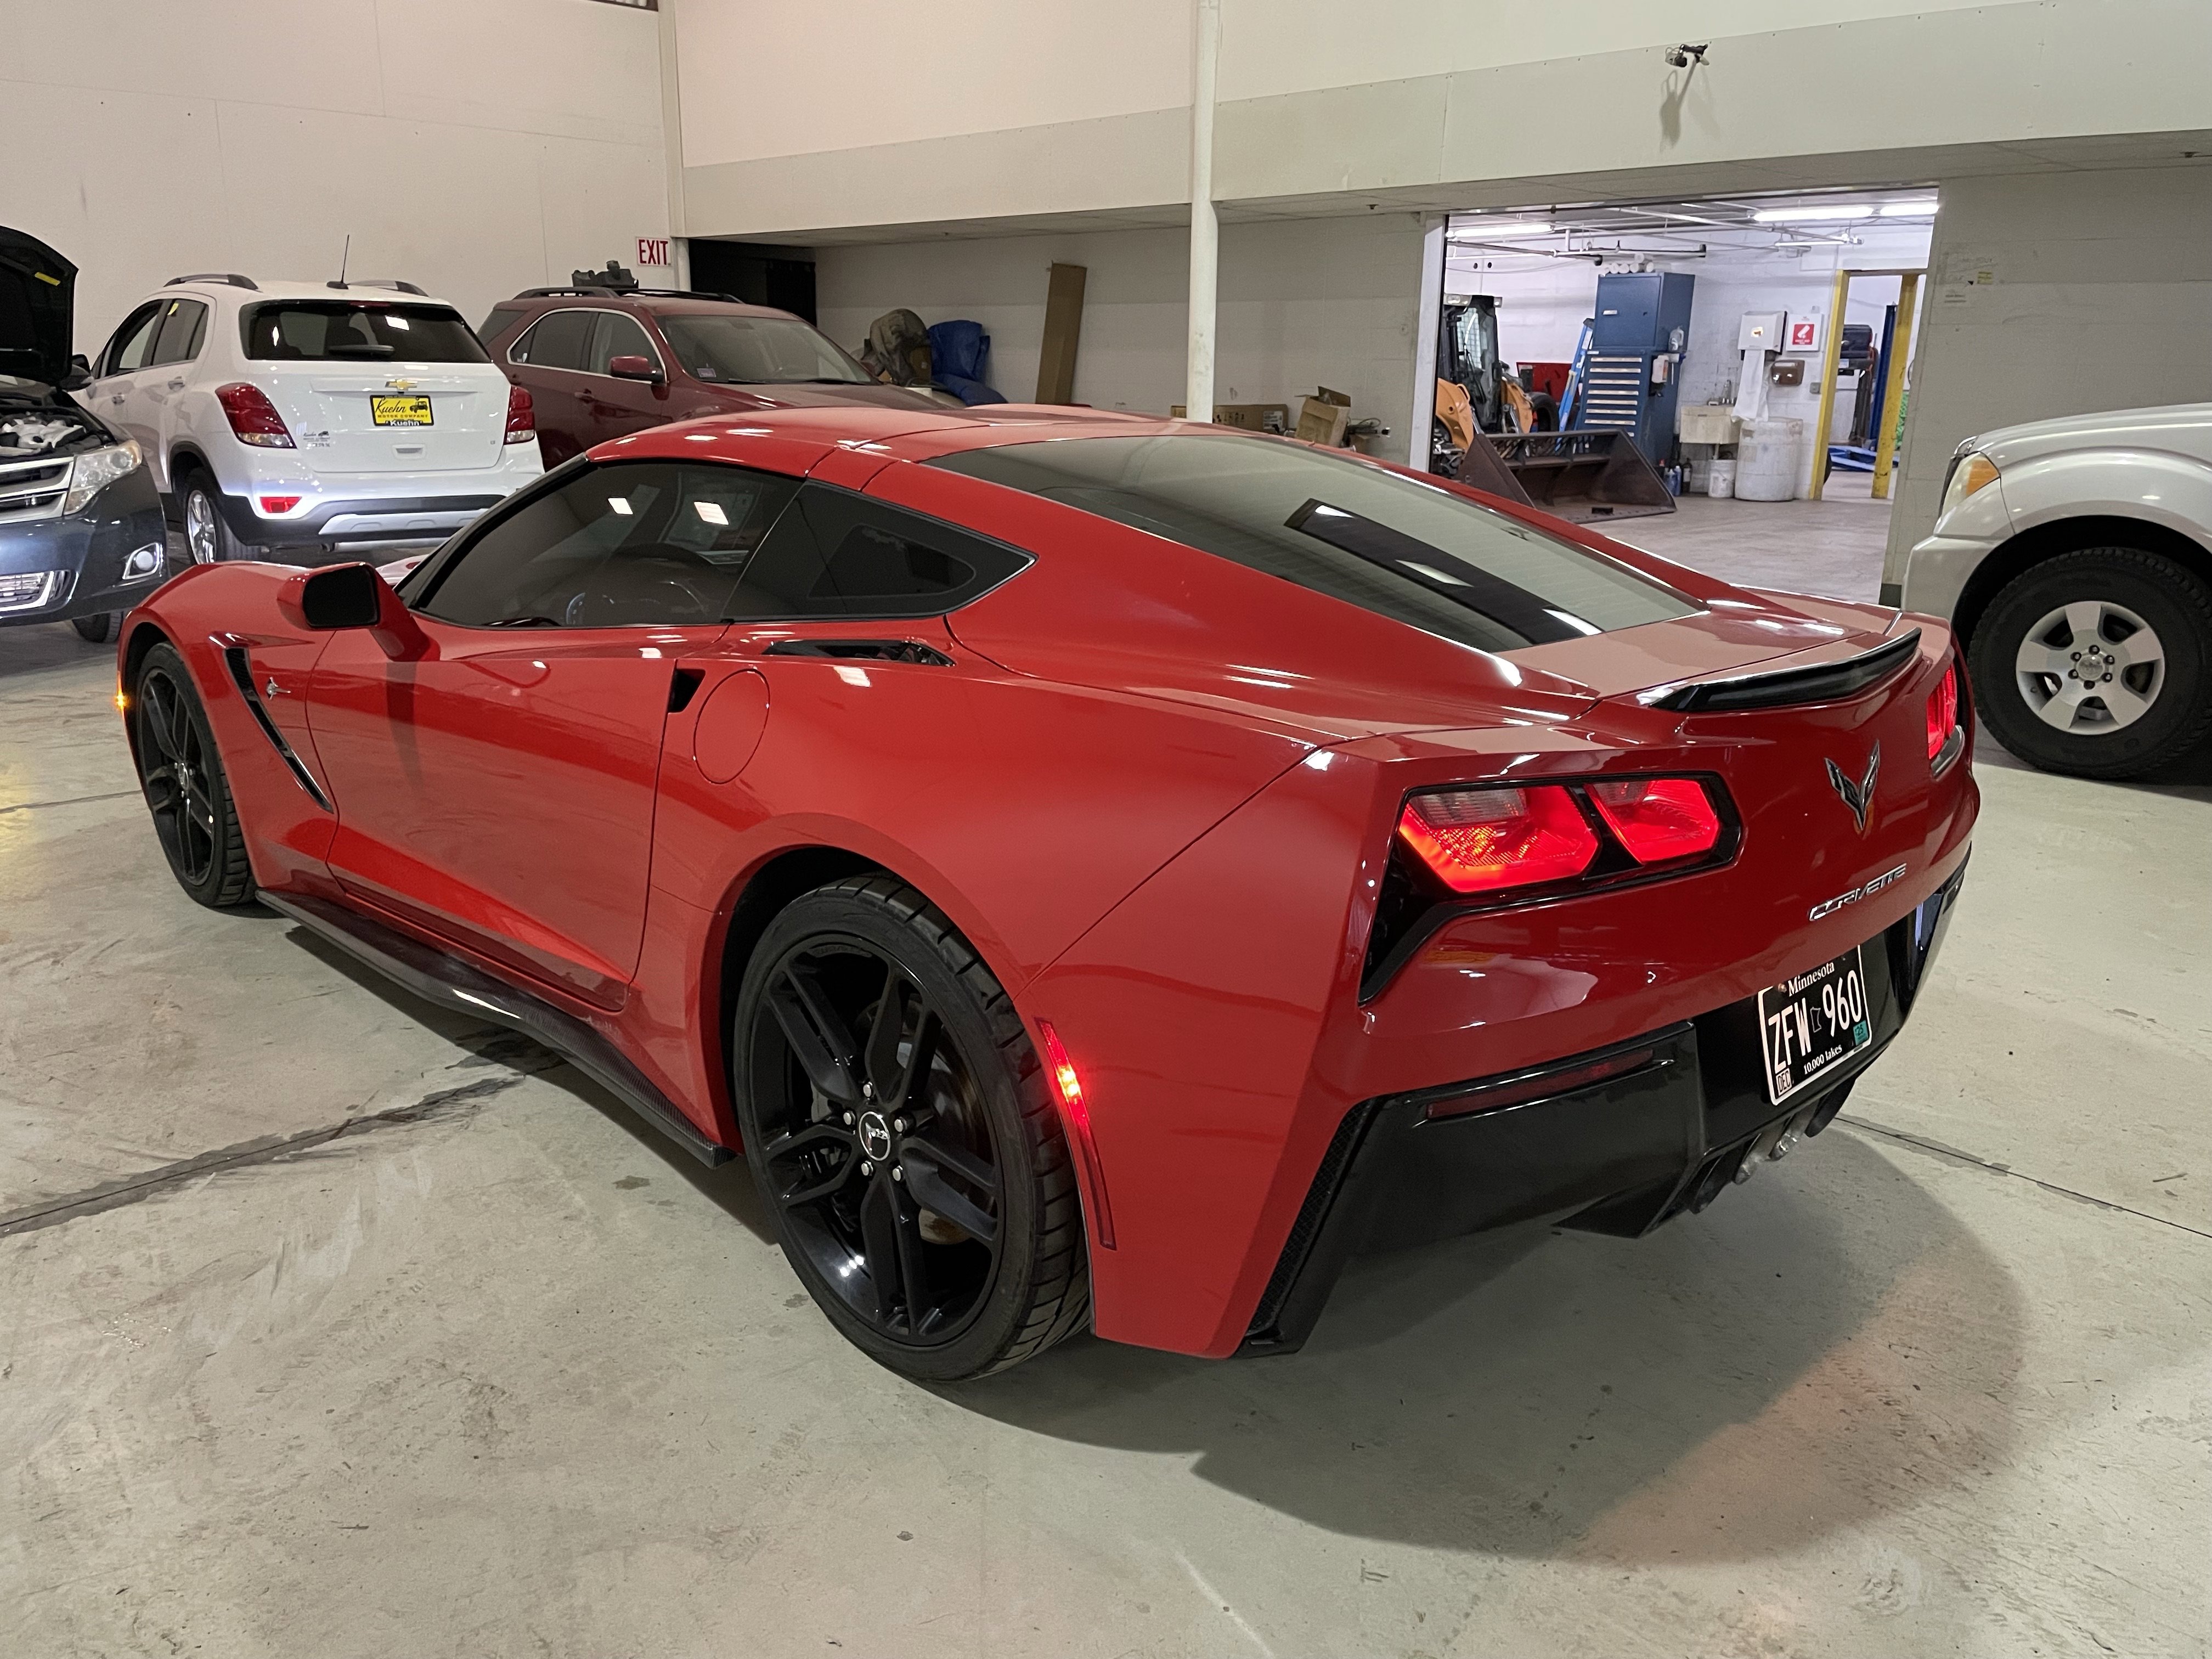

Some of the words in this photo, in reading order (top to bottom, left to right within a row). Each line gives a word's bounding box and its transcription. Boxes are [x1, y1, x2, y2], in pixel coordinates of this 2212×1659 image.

[639, 239, 668, 266] EXIT
[375, 399, 407, 415] Kuehn
[1809, 862, 1907, 922] CORVETTE
[1787, 961, 1835, 997] Minnesota
[1768, 997, 1812, 1074] ZFW
[1822, 970, 1861, 1037] 960
[1825, 1044, 1842, 1061] lakes
[1778, 1070, 1791, 1092] DEC
